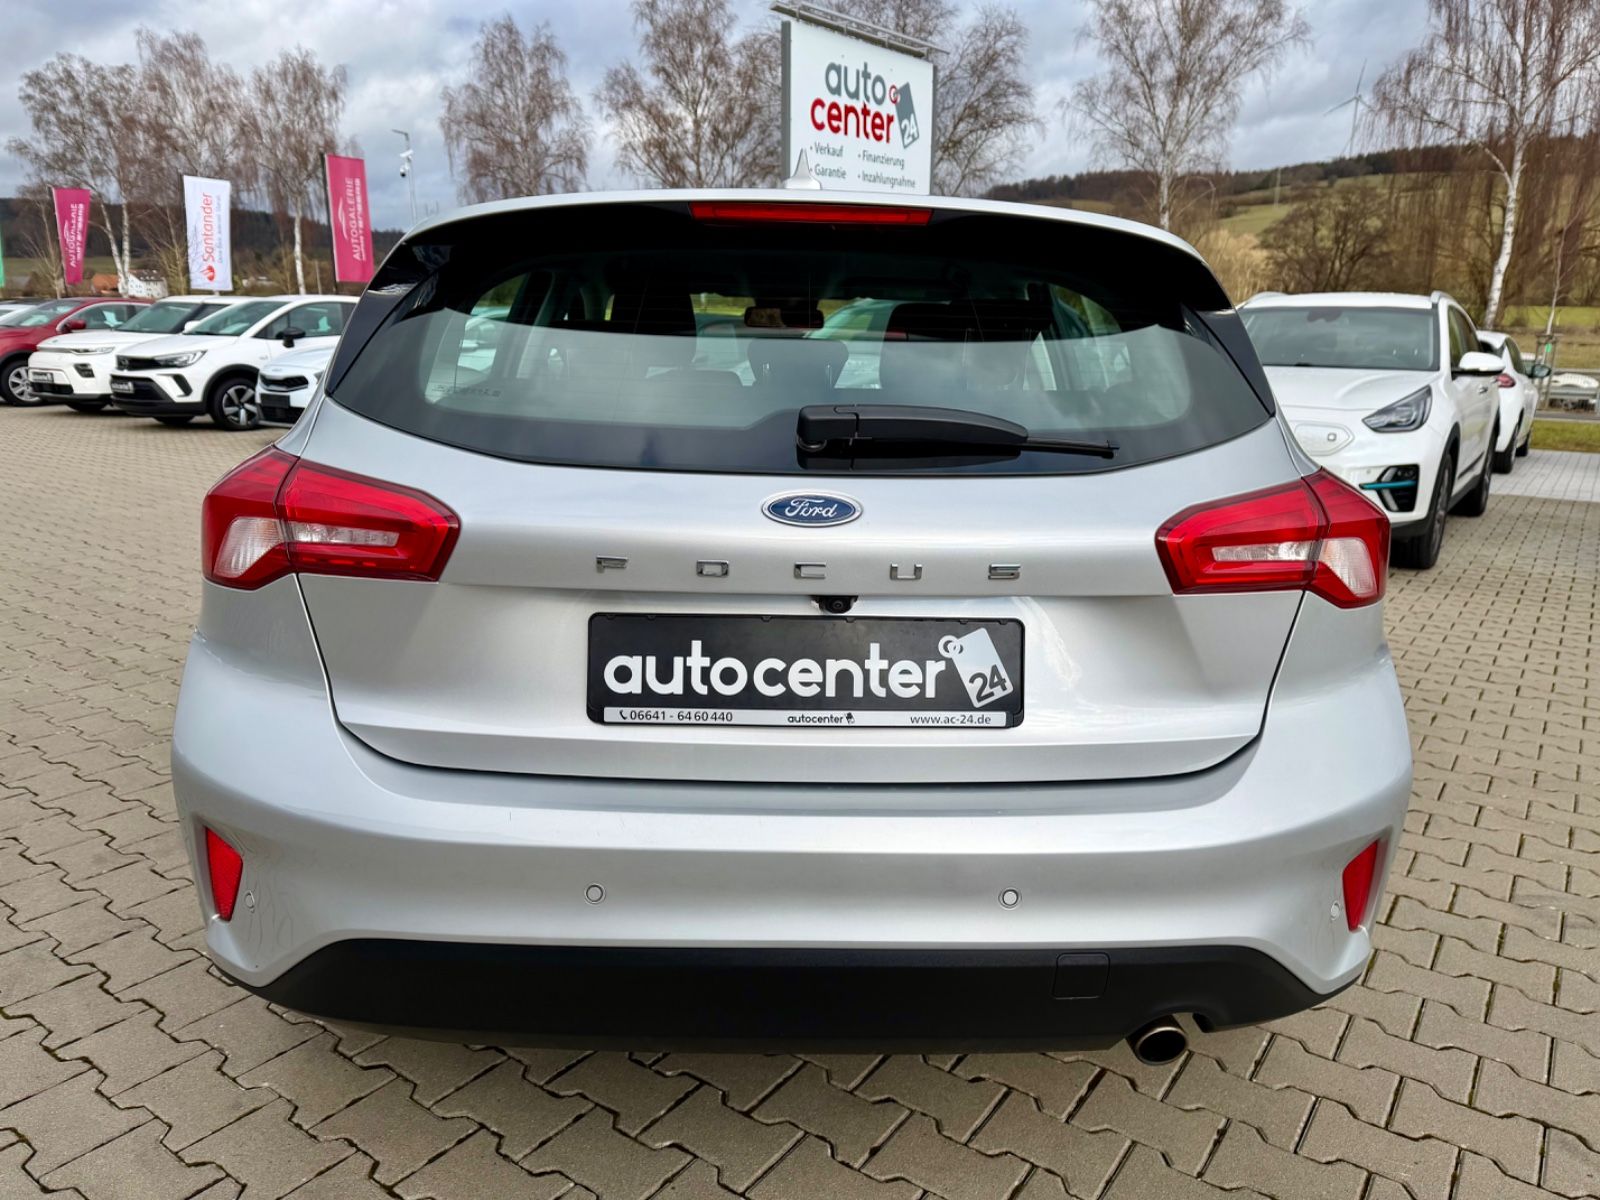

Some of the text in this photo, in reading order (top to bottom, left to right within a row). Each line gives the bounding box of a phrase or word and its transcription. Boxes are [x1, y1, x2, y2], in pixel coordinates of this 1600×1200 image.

[825, 62, 886, 106] auto
[810, 98, 894, 143] center
[901, 114, 918, 143] 24
[814, 142, 843, 157] Verkauf
[862, 149, 904, 170] Finanzierung
[814, 163, 846, 179] Garantie
[862, 170, 915, 189] Inzahlungnahme
[200, 192, 215, 262] Santander
[345, 177, 362, 261] AUTOGALERIE
[784, 498, 838, 517] Ford
[596, 556, 1022, 581] FOCUS
[603, 640, 946, 698] autocenter
[968, 664, 1008, 703] 24
[630, 710, 666, 720] 06641
[787, 711, 844, 724] autocenter
[910, 714, 992, 725] www.ac-24.de
